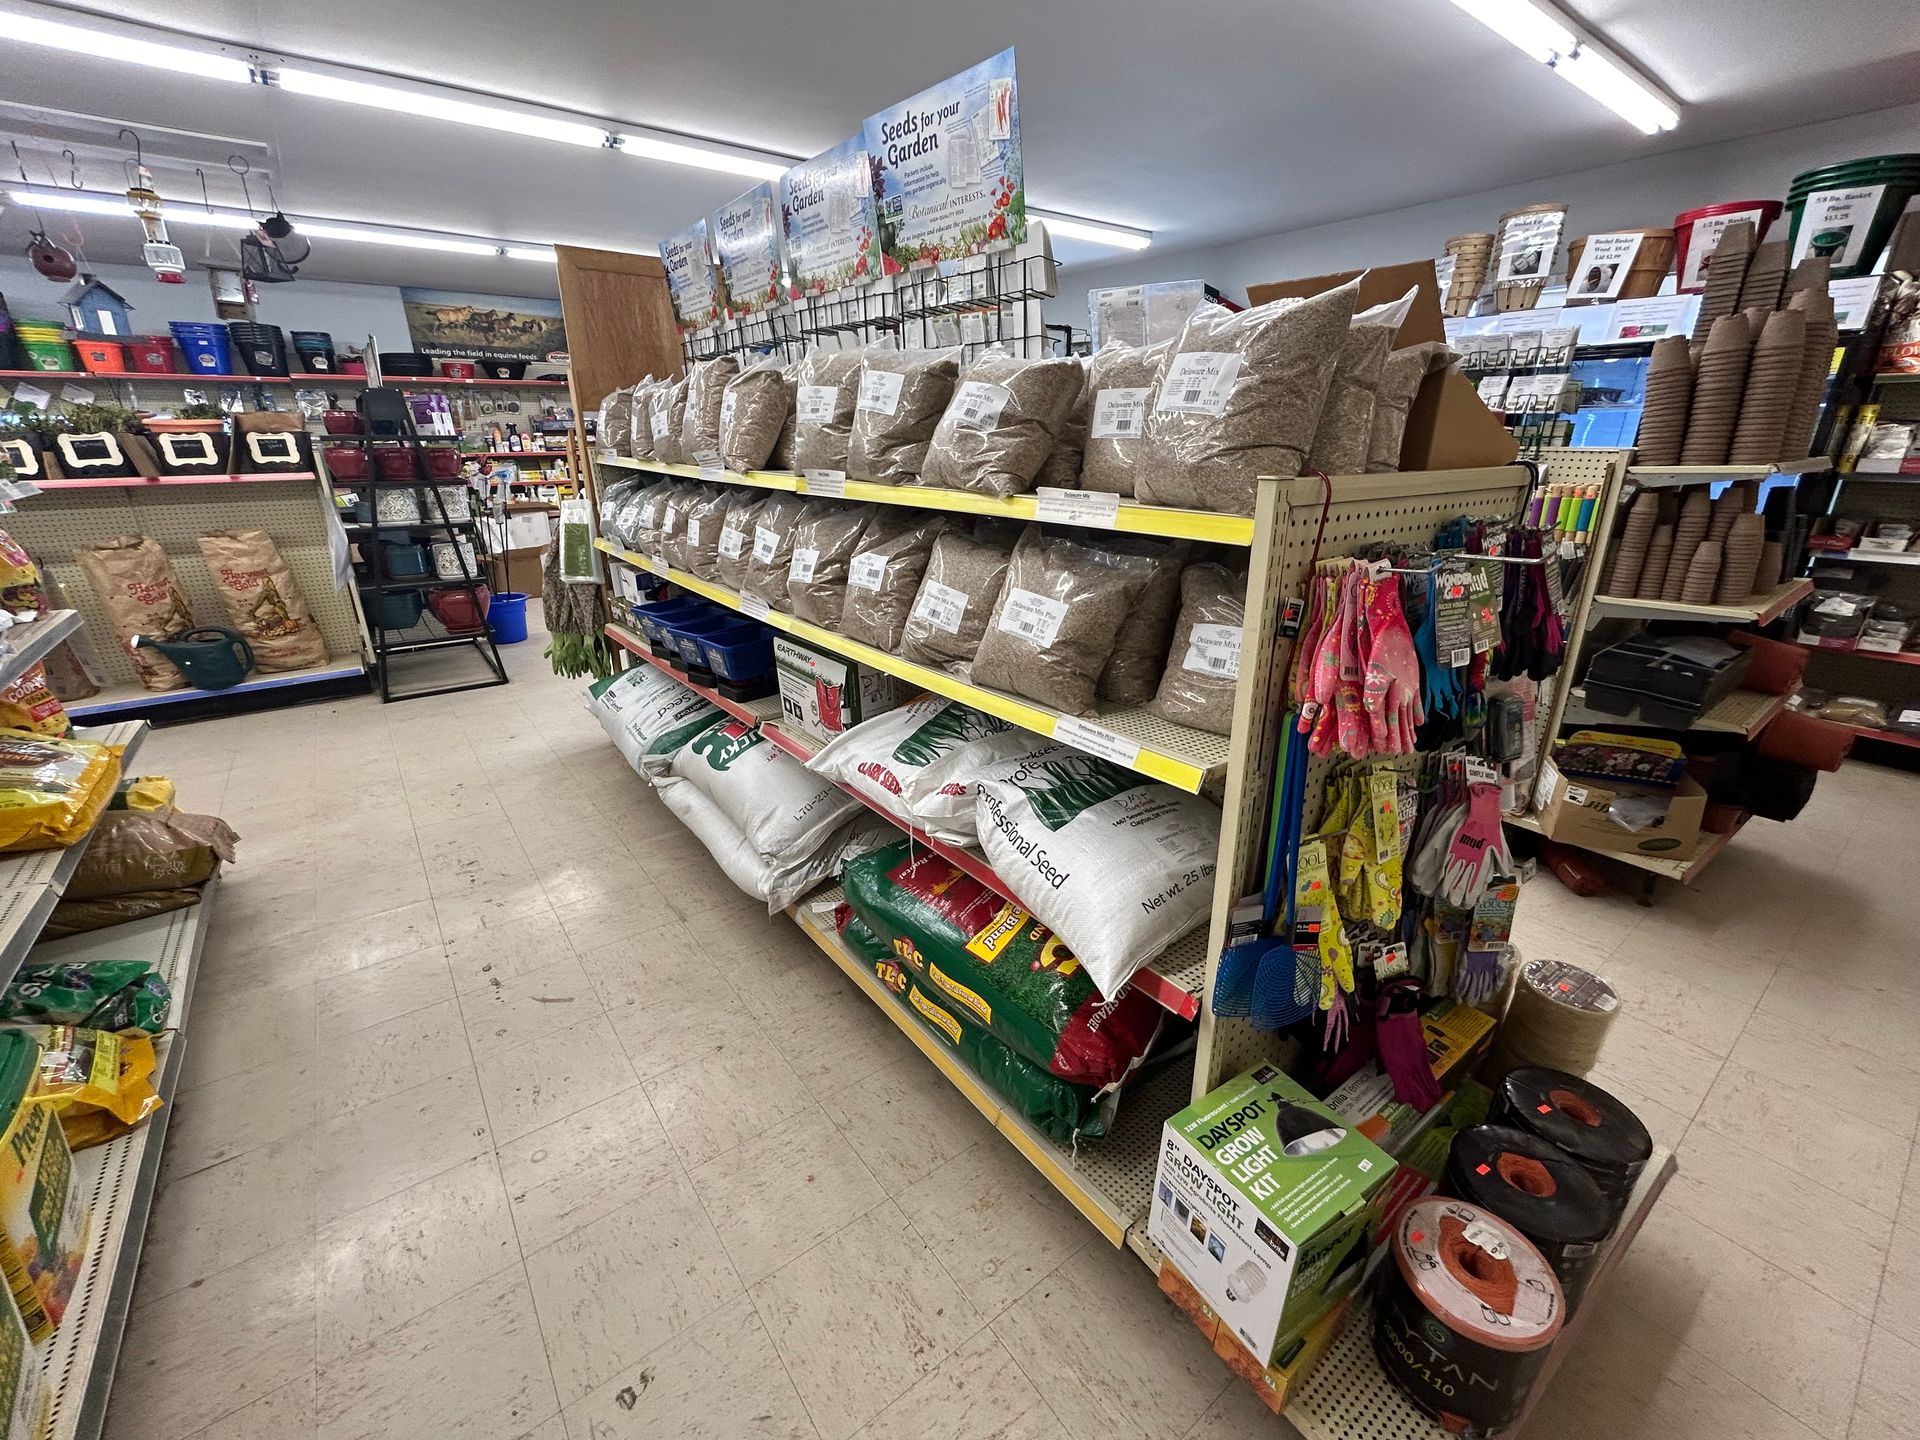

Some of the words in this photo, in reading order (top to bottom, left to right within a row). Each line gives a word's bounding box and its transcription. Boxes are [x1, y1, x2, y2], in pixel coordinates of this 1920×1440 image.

[881, 110, 918, 146] Seeds
[920, 111, 935, 132] for
[937, 100, 960, 126] your
[887, 132, 939, 170] Garden
[789, 174, 812, 196] Seeds
[1845, 191, 1872, 200] Basket
[792, 188, 825, 215] Garden
[909, 193, 950, 221] Botanical
[1826, 203, 1852, 212] Plastic
[720, 211, 736, 231] Seeds
[935, 221, 953, 233] educate
[961, 214, 982, 227] gardener
[722, 227, 745, 244] Garden
[665, 242, 680, 259] Seeds
[669, 257, 689, 274] Garden
[421, 347, 451, 357] Leading
[493, 352, 517, 360] equine
[1180, 367, 1205, 376] Delaware
[1205, 366, 1219, 376] Mix
[1108, 401, 1132, 409] Delaware
[221, 568, 270, 580] Harvest
[229, 579, 259, 591] Gold
[1435, 572, 1472, 590] WONDER
[1012, 600, 1034, 613] Delaware
[1034, 608, 1044, 617] Mix
[777, 644, 812, 663] EARTHWAY
[1196, 636, 1222, 647] Delaware
[1223, 640, 1236, 649] Mix
[657, 691, 692, 719] Seed
[1372, 781, 1395, 794] COOL
[1031, 850, 1070, 891] Seed
[1298, 853, 1326, 869] OOL
[1141, 897, 1165, 914] Net
[1166, 885, 1184, 899] wt.
[1183, 869, 1199, 886] 25
[1201, 863, 1217, 879] lbs.
[983, 914, 1019, 951] Blend
[893, 938, 924, 968] TLC
[875, 961, 907, 990] TLC
[1087, 1001, 1119, 1033] SHADE!
[11, 1103, 45, 1167] Preen
[1197, 1099, 1266, 1150] DAYSPOT
[1215, 1125, 1266, 1165] GROW
[1166, 1139, 1180, 1151] 8"
[1184, 1154, 1241, 1212] DAYSPOT
[1230, 1144, 1279, 1184] LIGHT
[1165, 1150, 1203, 1190] GROW
[1206, 1190, 1245, 1230] LIGHT
[1248, 1172, 1281, 1201] KIT
[1189, 1184, 1217, 1215] Agrobrite
[1217, 1213, 1253, 1250] Fluorescent
[1253, 1248, 1272, 1270] Lamp
